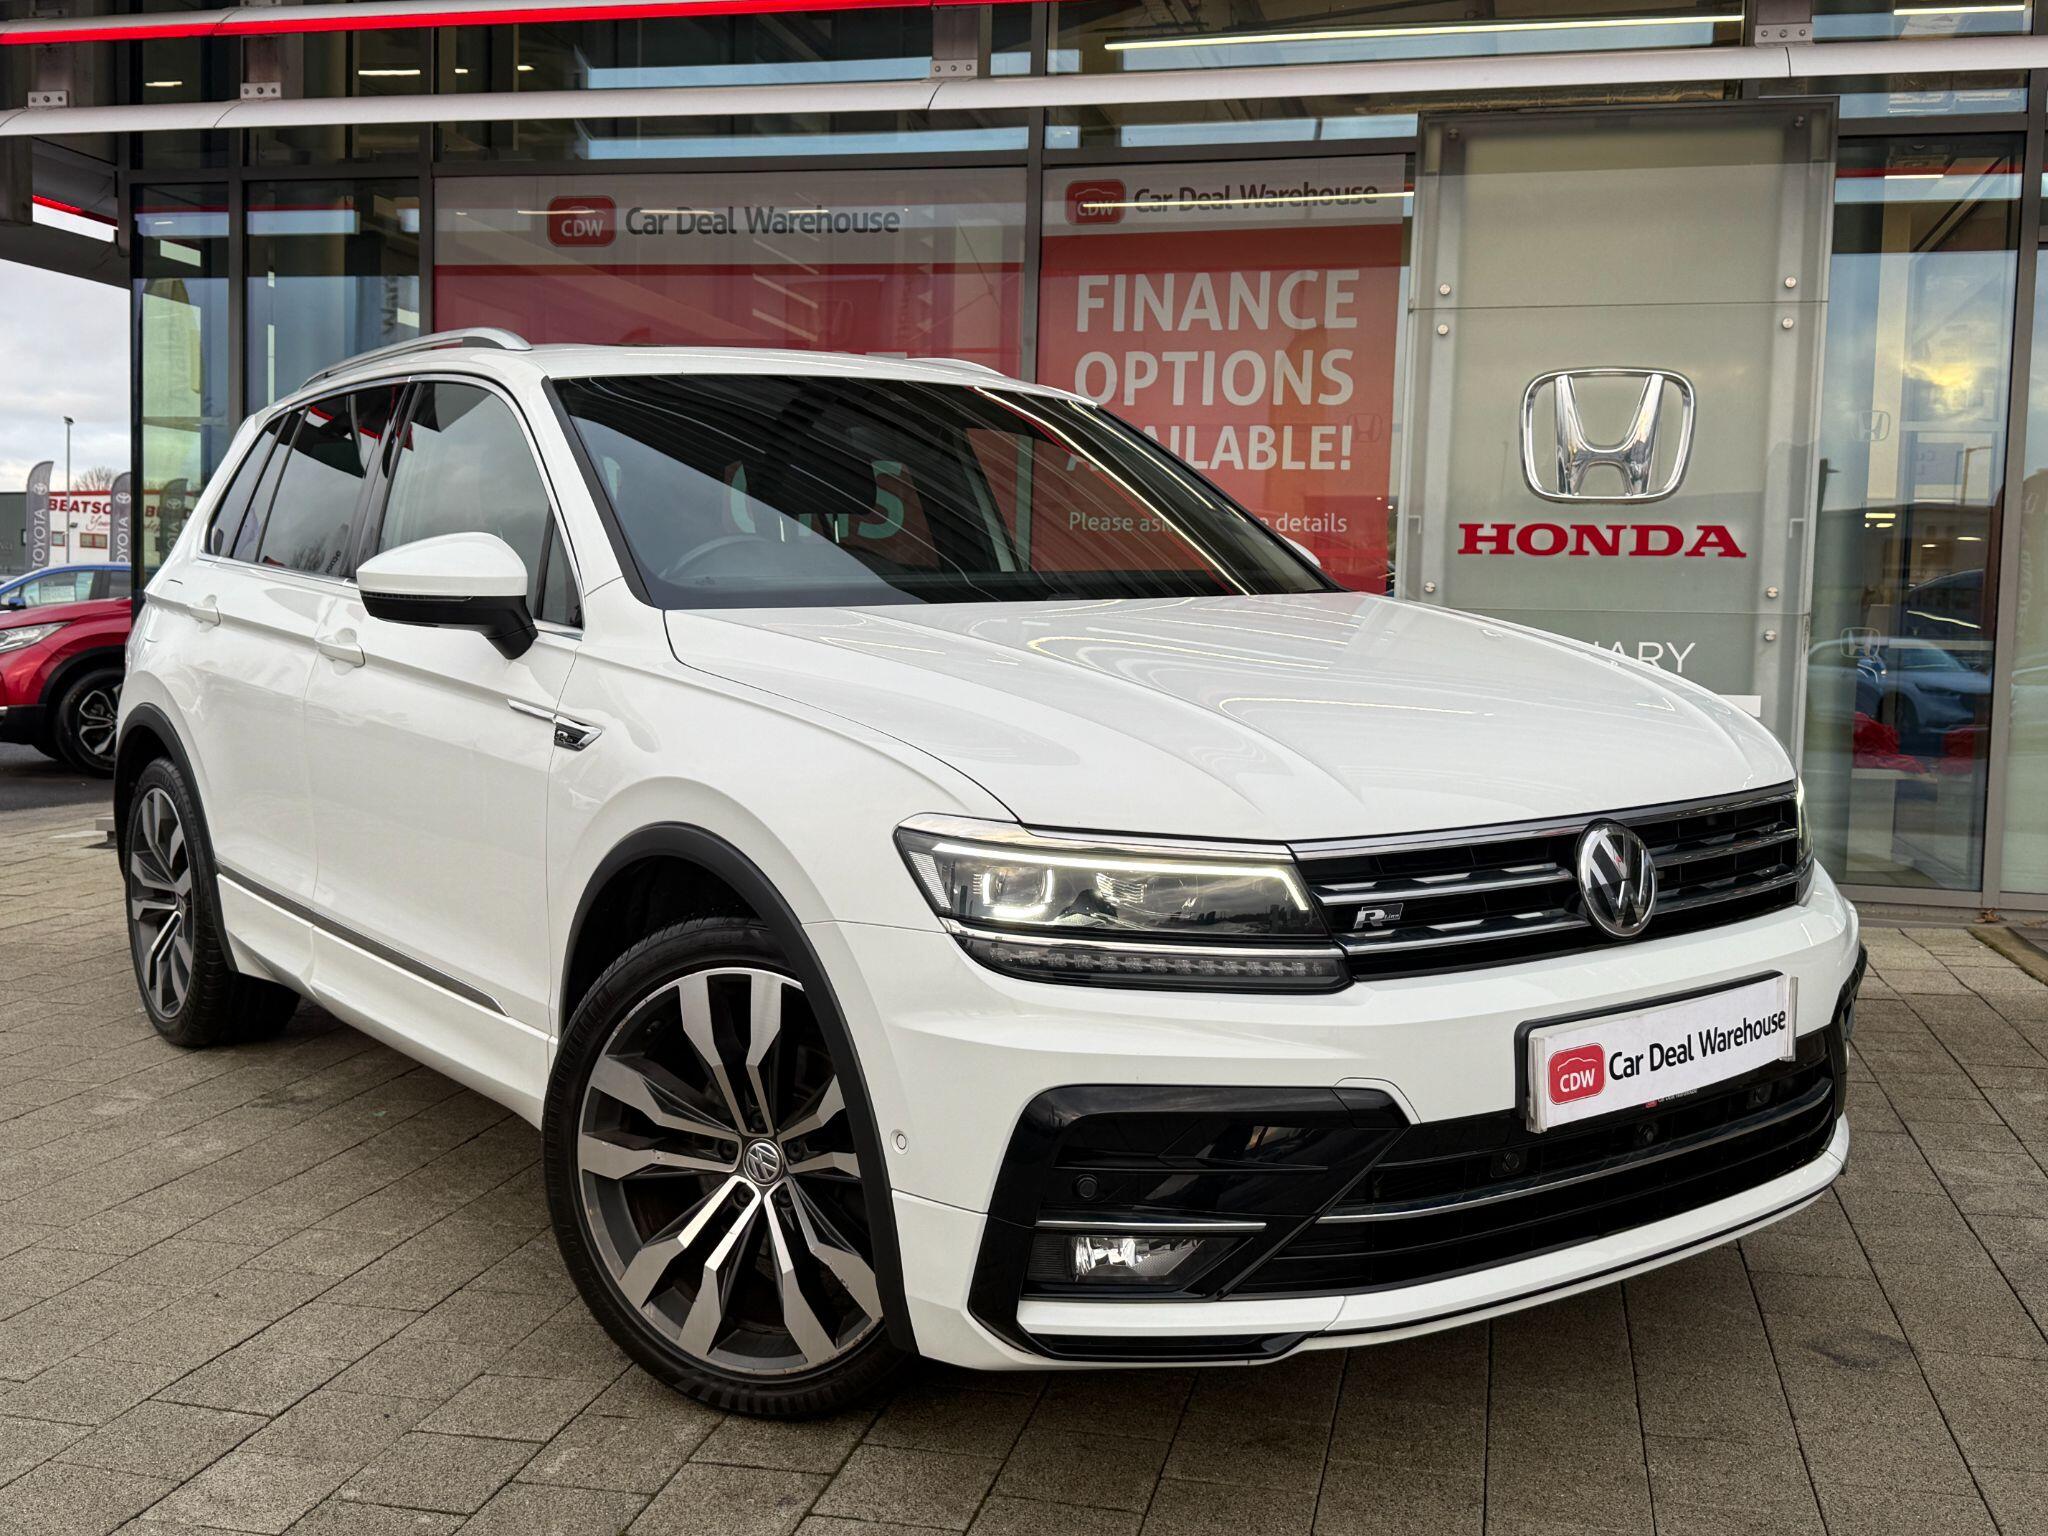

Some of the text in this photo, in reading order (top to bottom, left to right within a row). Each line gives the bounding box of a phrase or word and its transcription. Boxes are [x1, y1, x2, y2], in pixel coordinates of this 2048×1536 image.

[1077, 201, 1115, 217] CDW
[1133, 182, 1378, 213] Car Deal Warehouse
[561, 219, 604, 237] CDW
[625, 204, 900, 235] Car Deal Warehouse
[1076, 269, 1359, 332] FINANCE
[1074, 348, 1354, 406] OPTIONS
[1066, 425, 1353, 471] ILABLE!
[32, 508, 47, 568] TOYOTA
[116, 516, 129, 562] OYOTA
[1068, 511, 1134, 531] Please
[1275, 512, 1348, 532] details
[1457, 523, 1747, 558] HONDA
[1609, 1010, 1786, 1081] Car Deal Warehouse
[1559, 1067, 1596, 1093] CDW
